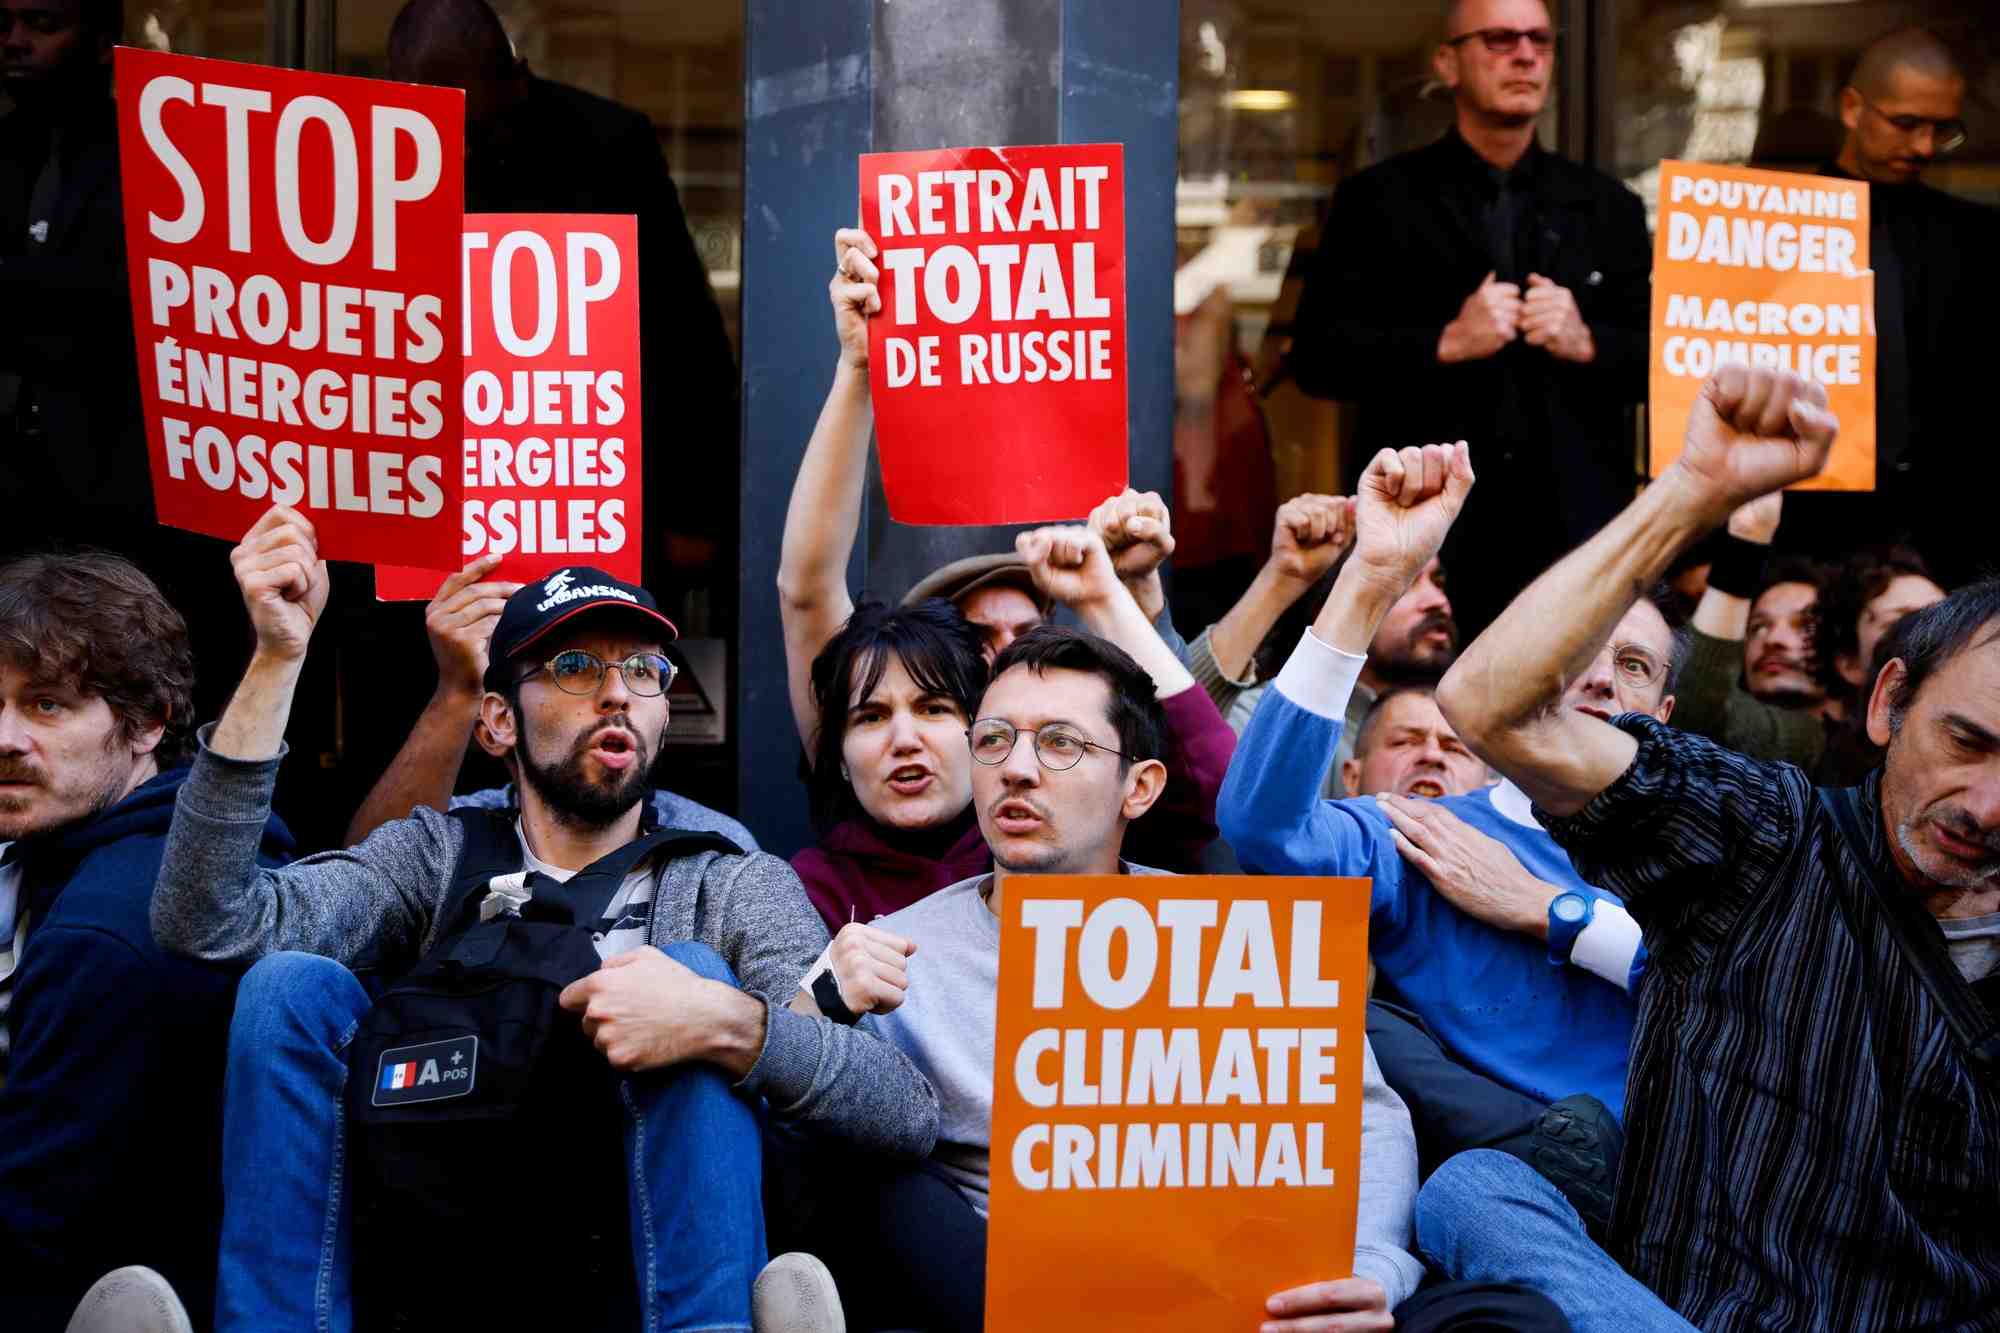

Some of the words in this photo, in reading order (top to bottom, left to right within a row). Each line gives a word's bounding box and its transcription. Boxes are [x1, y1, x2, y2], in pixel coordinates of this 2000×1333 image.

[139, 75, 442, 271] STOP
[878, 166, 1108, 237] RETRAIT
[1671, 175, 1857, 220] POUYANNÉ
[1667, 211, 1857, 277] DANGER
[149, 258, 443, 363] PROJETS
[462, 230, 621, 357] TOP
[883, 242, 1110, 325] TOTAL
[1665, 294, 1860, 336] MACRON
[155, 337, 444, 440] ÉNERGIES
[885, 336, 941, 388] DE
[960, 330, 1112, 385] RUSSIE
[463, 370, 625, 426] OJETS
[162, 417, 444, 518] FOSSILES
[463, 437, 626, 487] ERGIES
[463, 498, 626, 555] SSILES
[1021, 898, 1340, 1010] TOTAL
[417, 1058, 440, 1086] A
[442, 1067, 469, 1081] POS
[1014, 1028, 1337, 1108] CLIMATE
[1012, 1123, 1334, 1190] CRIMINAL
